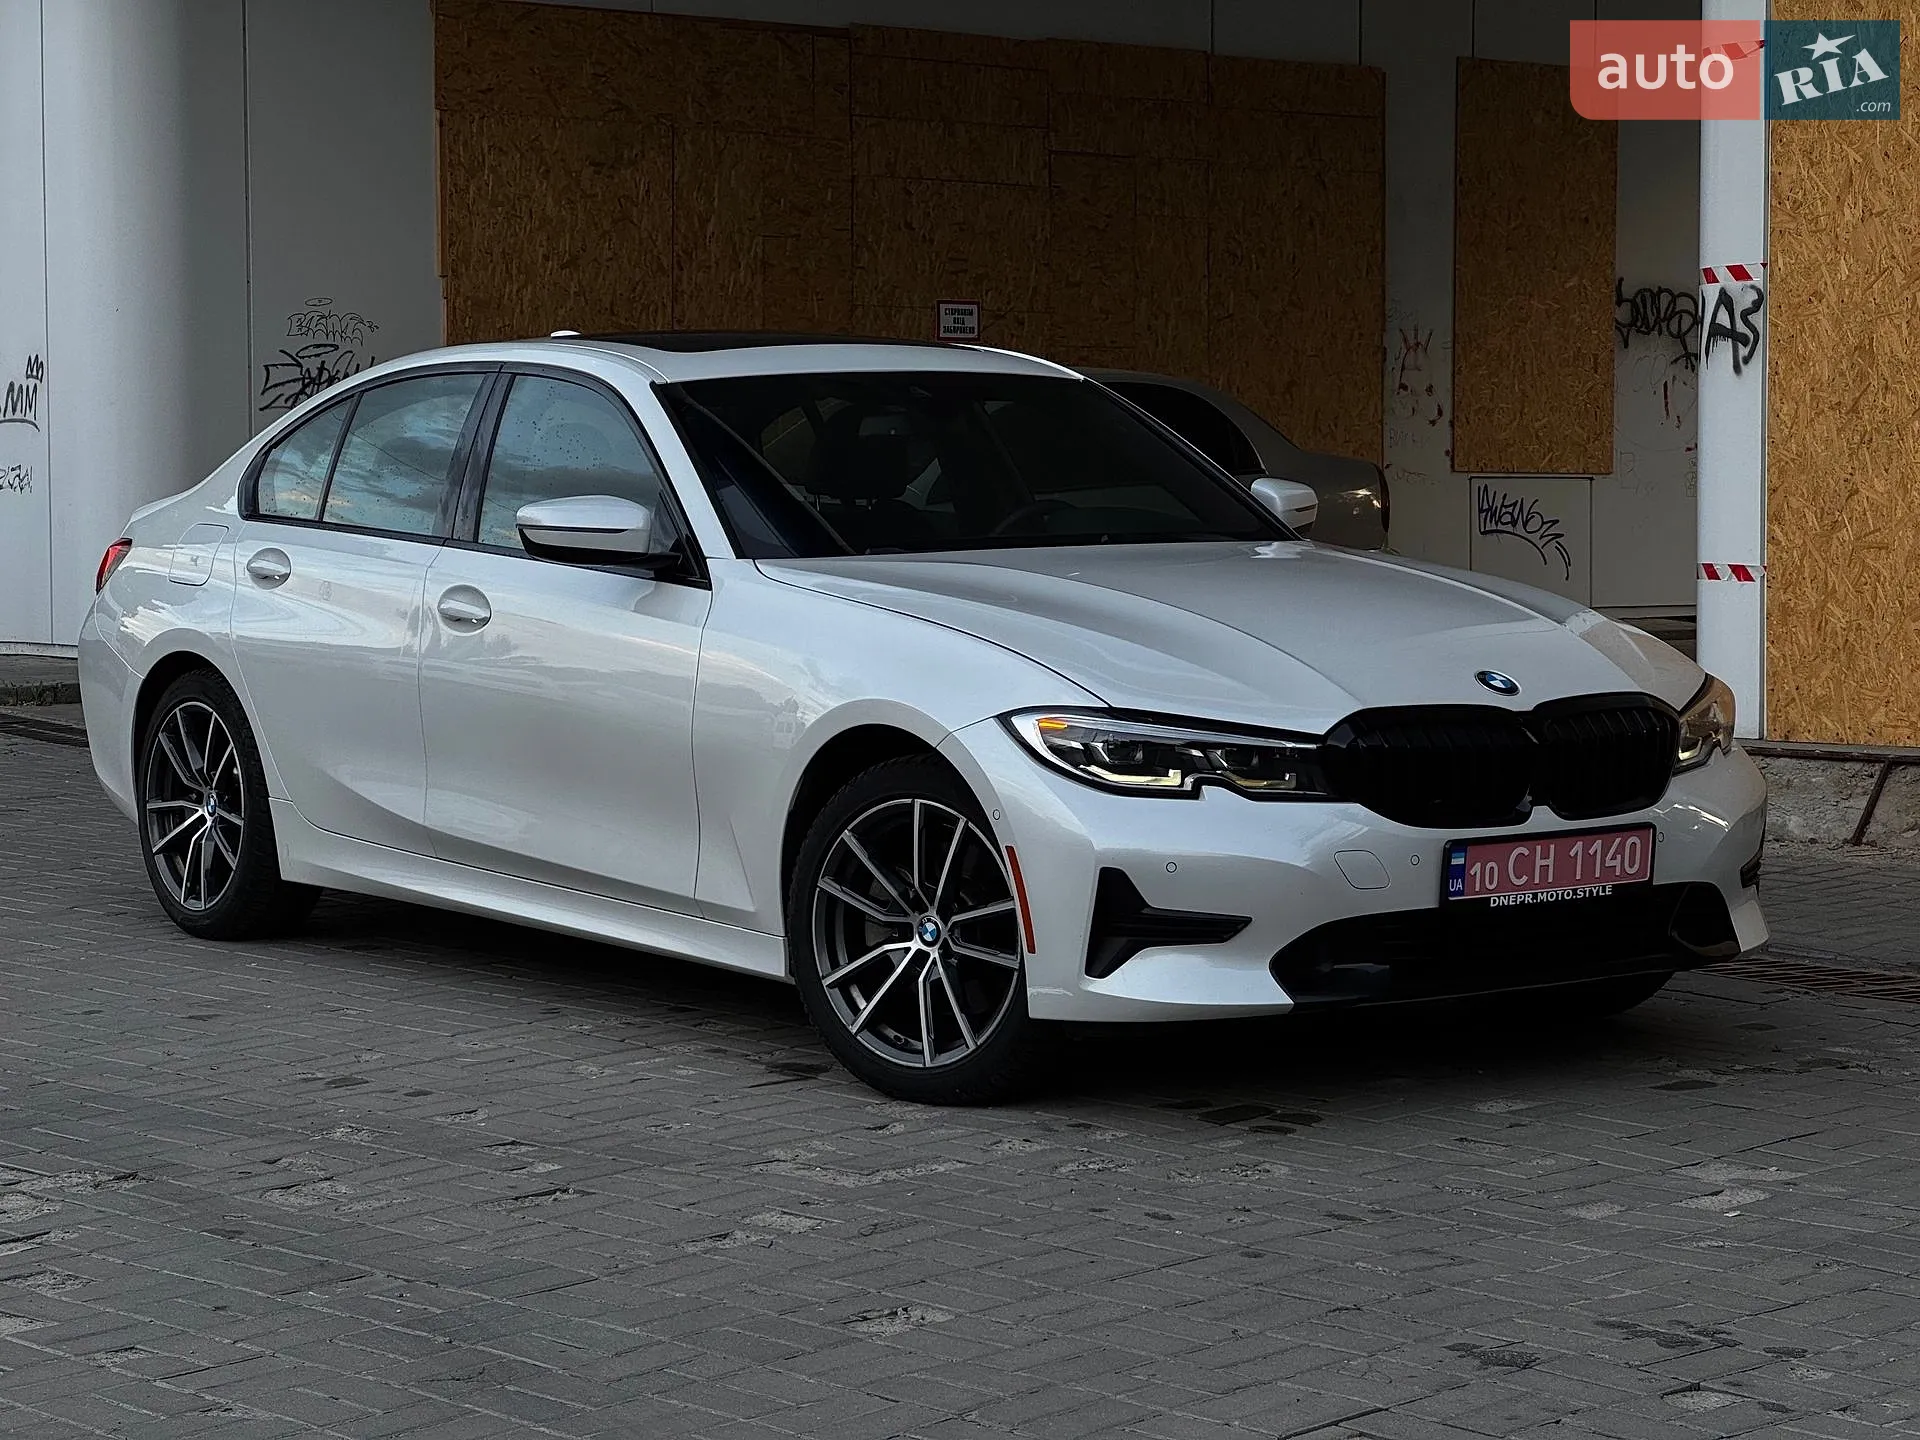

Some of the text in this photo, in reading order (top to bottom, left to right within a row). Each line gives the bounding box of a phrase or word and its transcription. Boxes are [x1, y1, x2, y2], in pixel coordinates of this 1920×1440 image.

[1470, 836, 1641, 892] 10 CH 1140
[1449, 878, 1463, 891] UA
[1490, 885, 1613, 907] DNEPR.MOTO.STYLE
